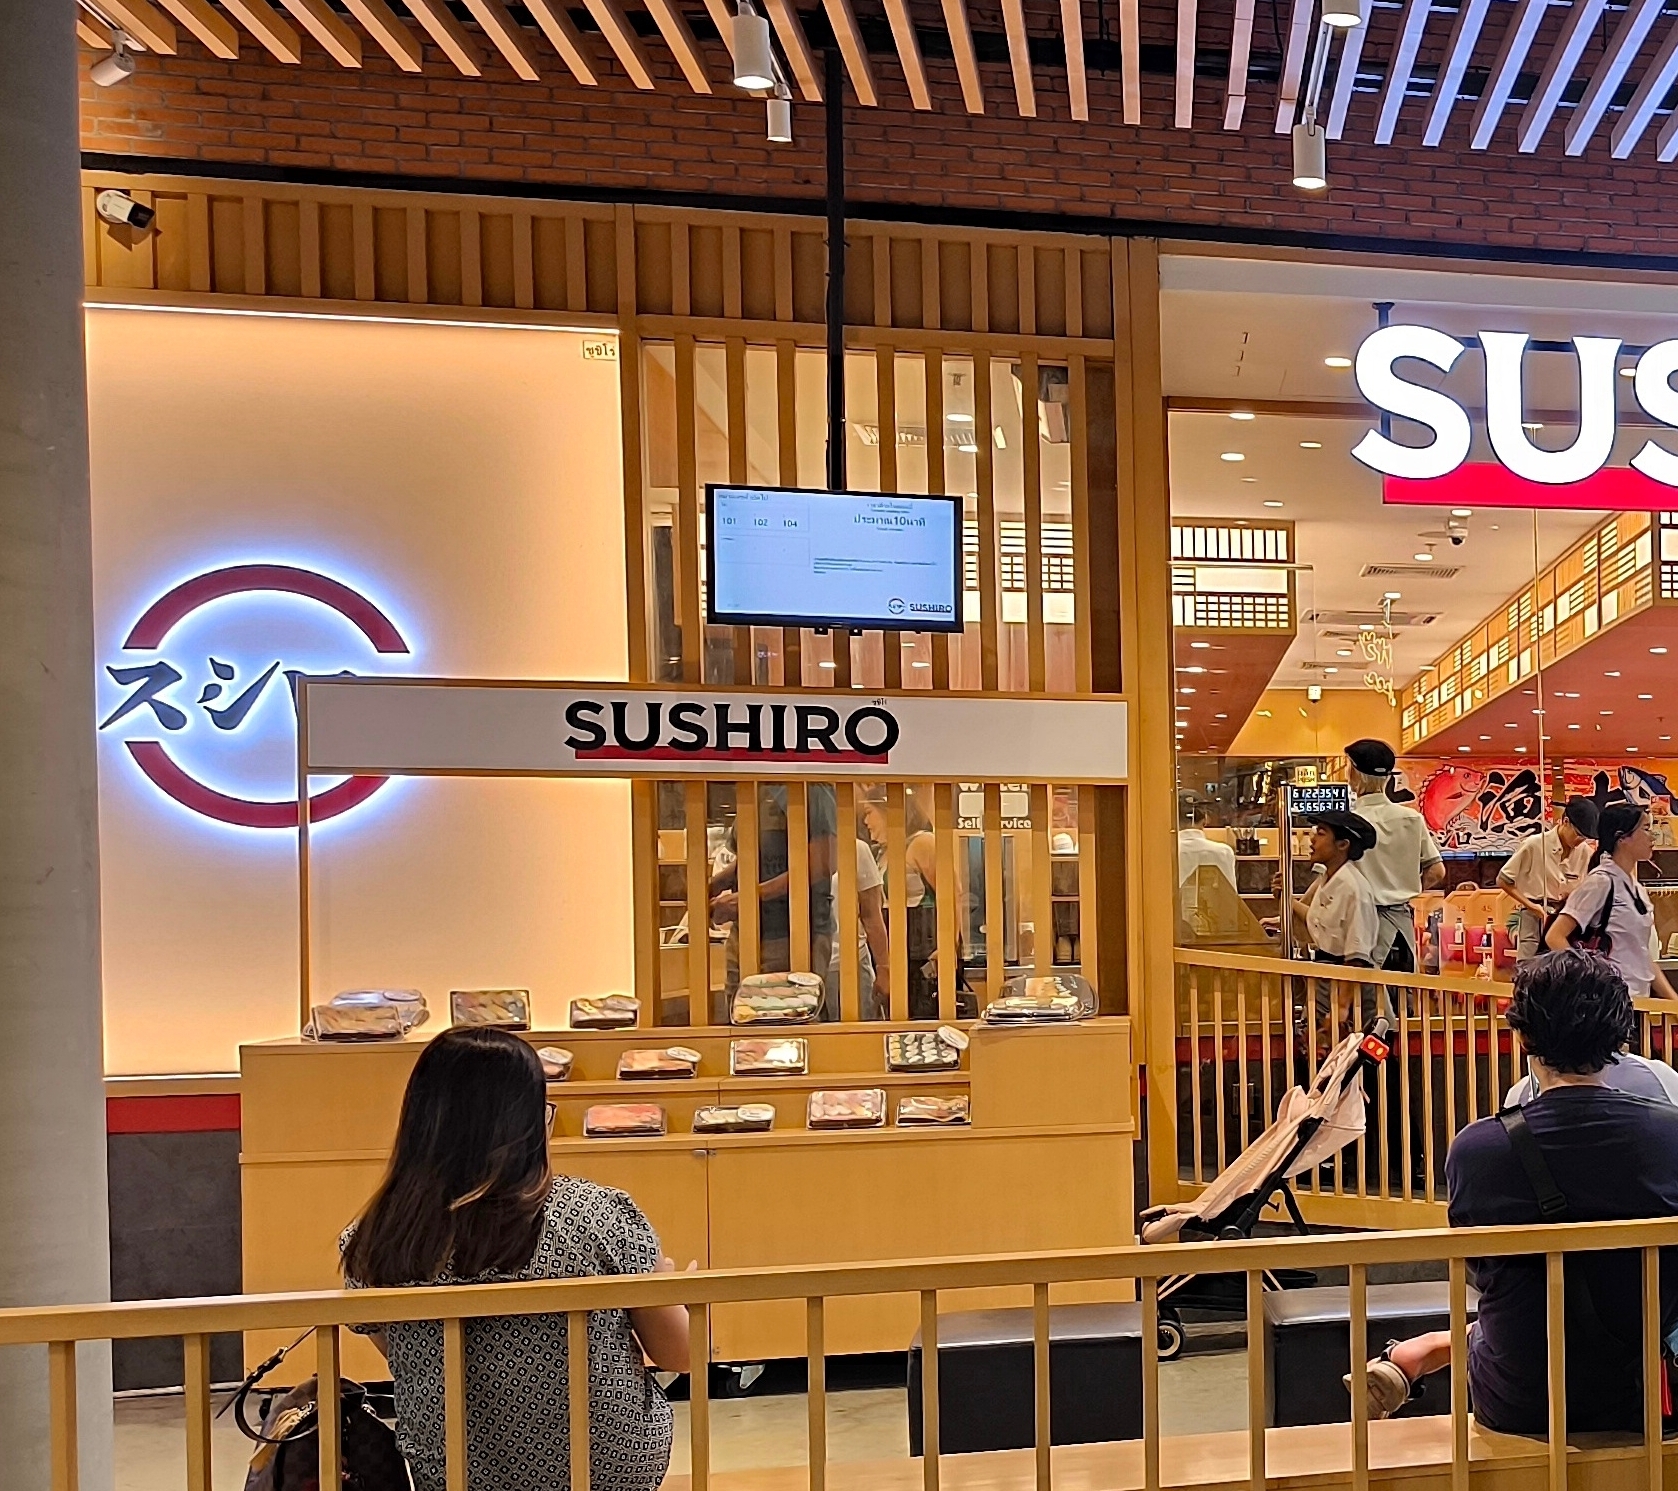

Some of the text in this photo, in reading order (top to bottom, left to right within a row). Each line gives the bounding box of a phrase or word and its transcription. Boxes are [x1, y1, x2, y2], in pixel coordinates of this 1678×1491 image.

[722, 517, 798, 528] 101 102 104
[909, 603, 953, 613] SUSHIRO
[98, 657, 357, 732] スシ
[563, 700, 900, 756] SUSHIRO
